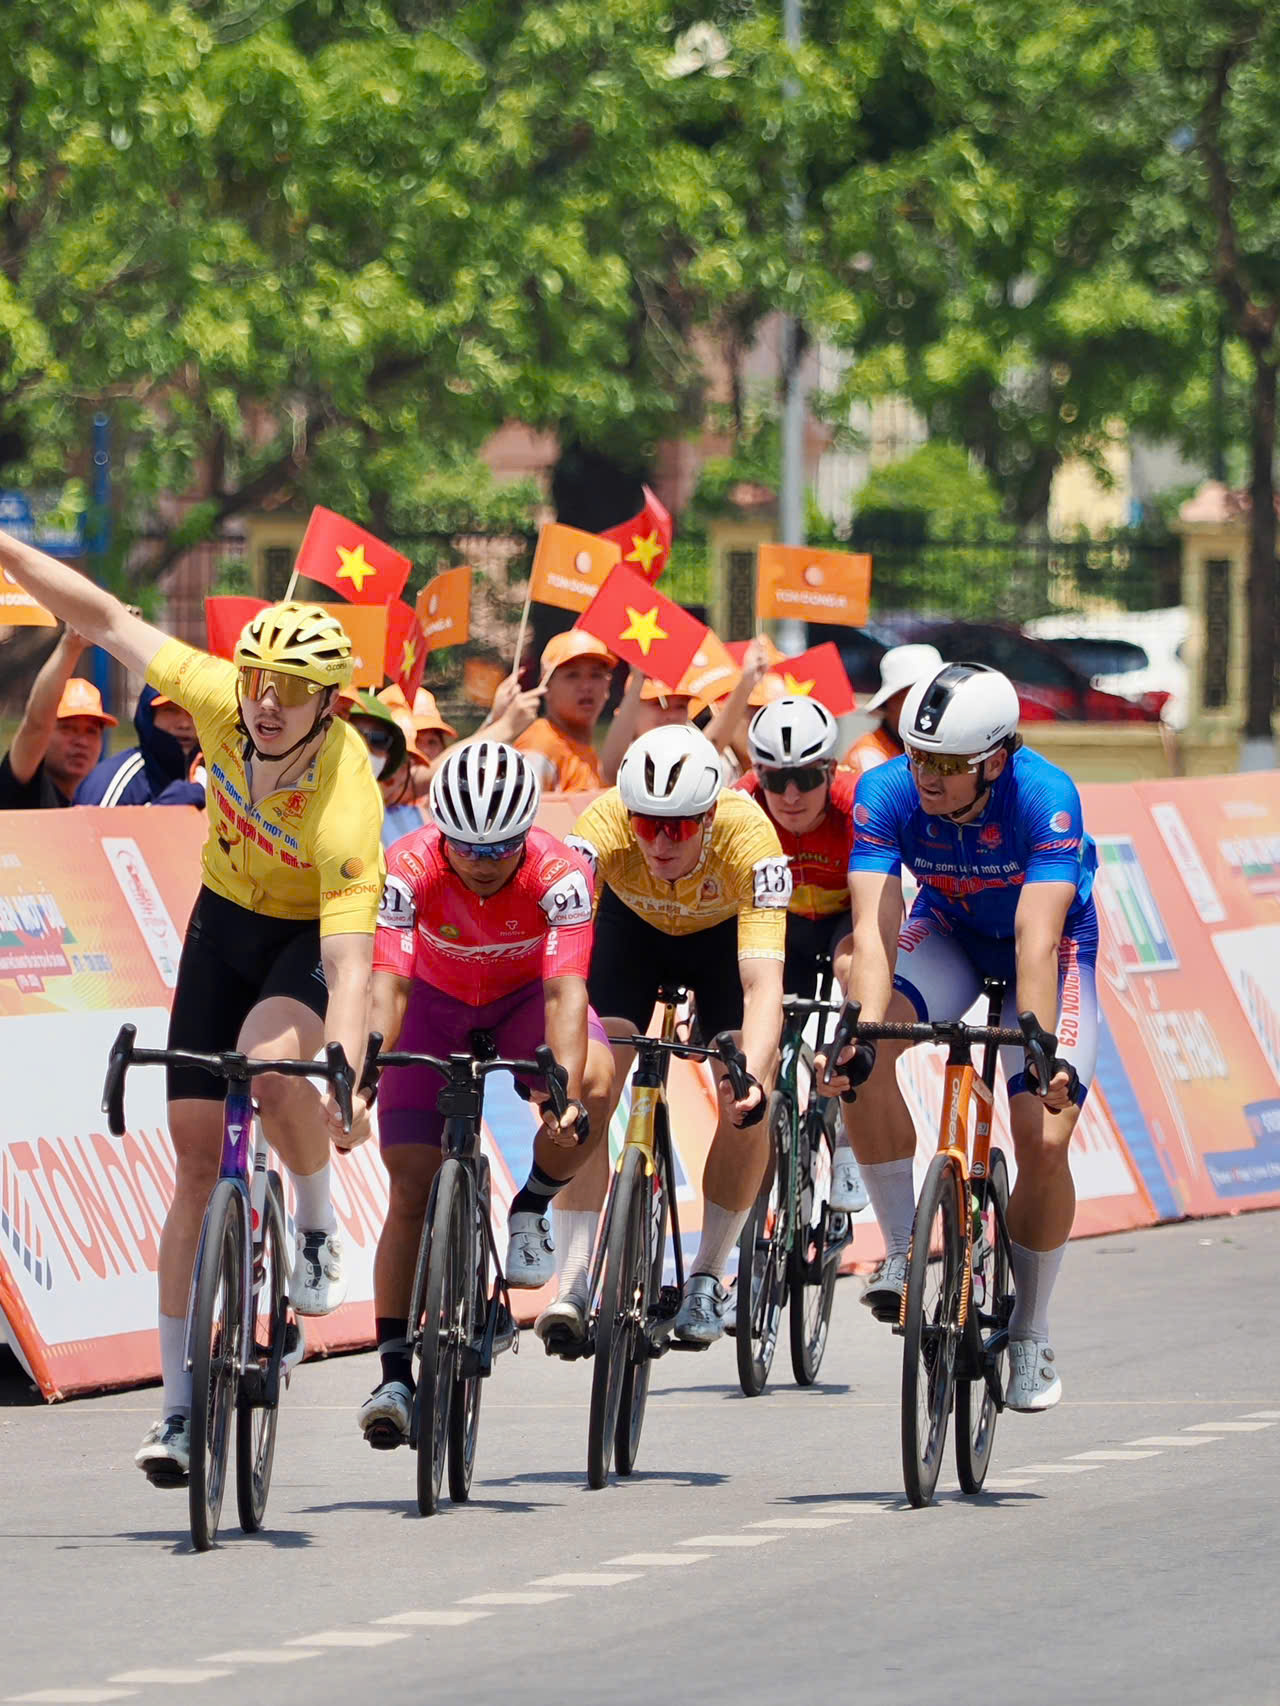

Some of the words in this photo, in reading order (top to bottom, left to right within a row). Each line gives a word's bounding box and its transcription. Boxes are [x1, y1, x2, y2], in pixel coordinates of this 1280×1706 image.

[321, 889, 342, 901] TON
[344, 884, 378, 897] DONG
[759, 865, 787, 894] 13
[554, 884, 583, 912] 91
[1058, 1017, 1079, 1049] 620
[8, 1135, 138, 1281] TON
